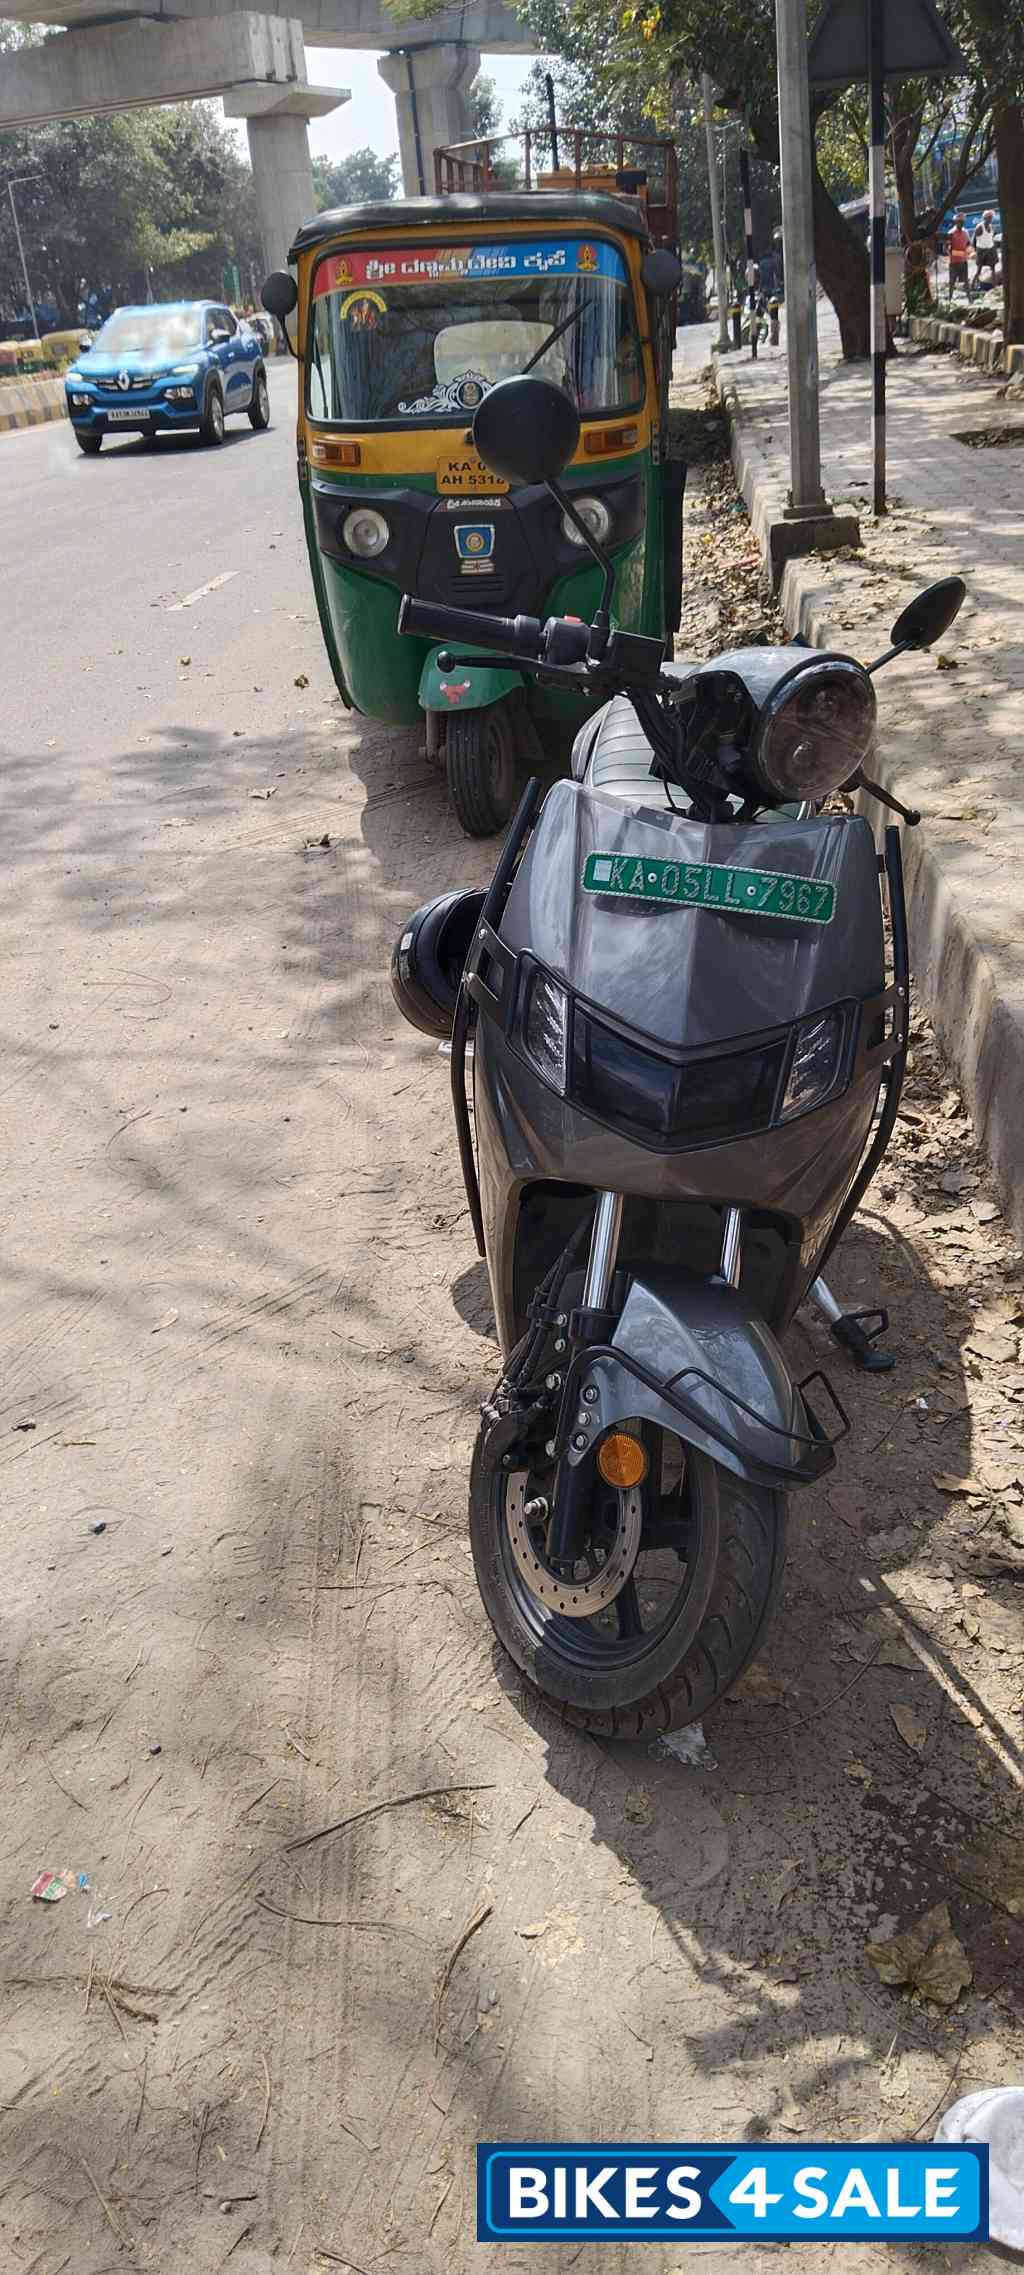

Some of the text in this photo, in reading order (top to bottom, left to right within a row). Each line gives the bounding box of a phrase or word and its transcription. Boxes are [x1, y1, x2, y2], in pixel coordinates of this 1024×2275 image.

[448, 462, 471, 471] KA
[440, 475, 462, 485] AH
[609, 858, 646, 892] KA
[757, 876, 830, 917] 7967
